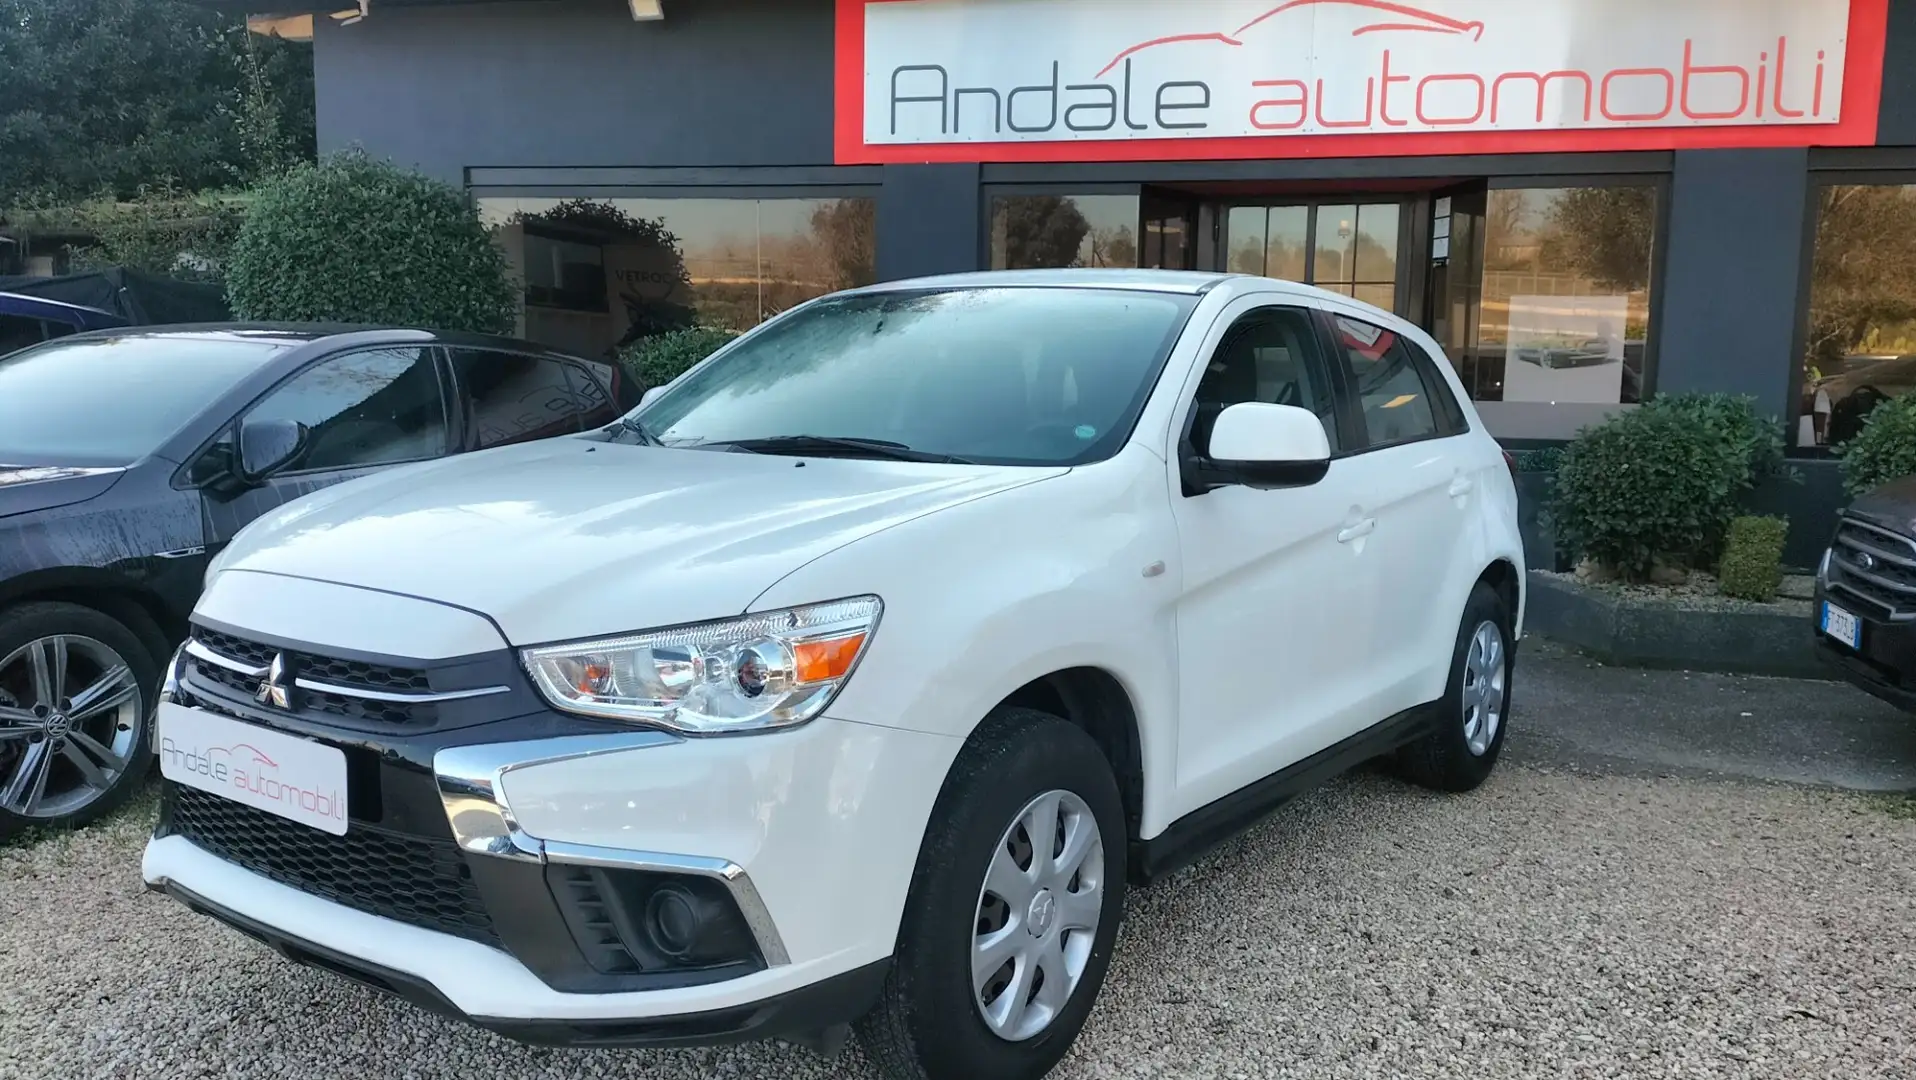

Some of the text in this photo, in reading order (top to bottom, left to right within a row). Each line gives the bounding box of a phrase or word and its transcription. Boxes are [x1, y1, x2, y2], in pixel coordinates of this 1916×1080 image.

[891, 35, 1825, 135] Andale automobili
[162, 737, 345, 821] Andale automobili
